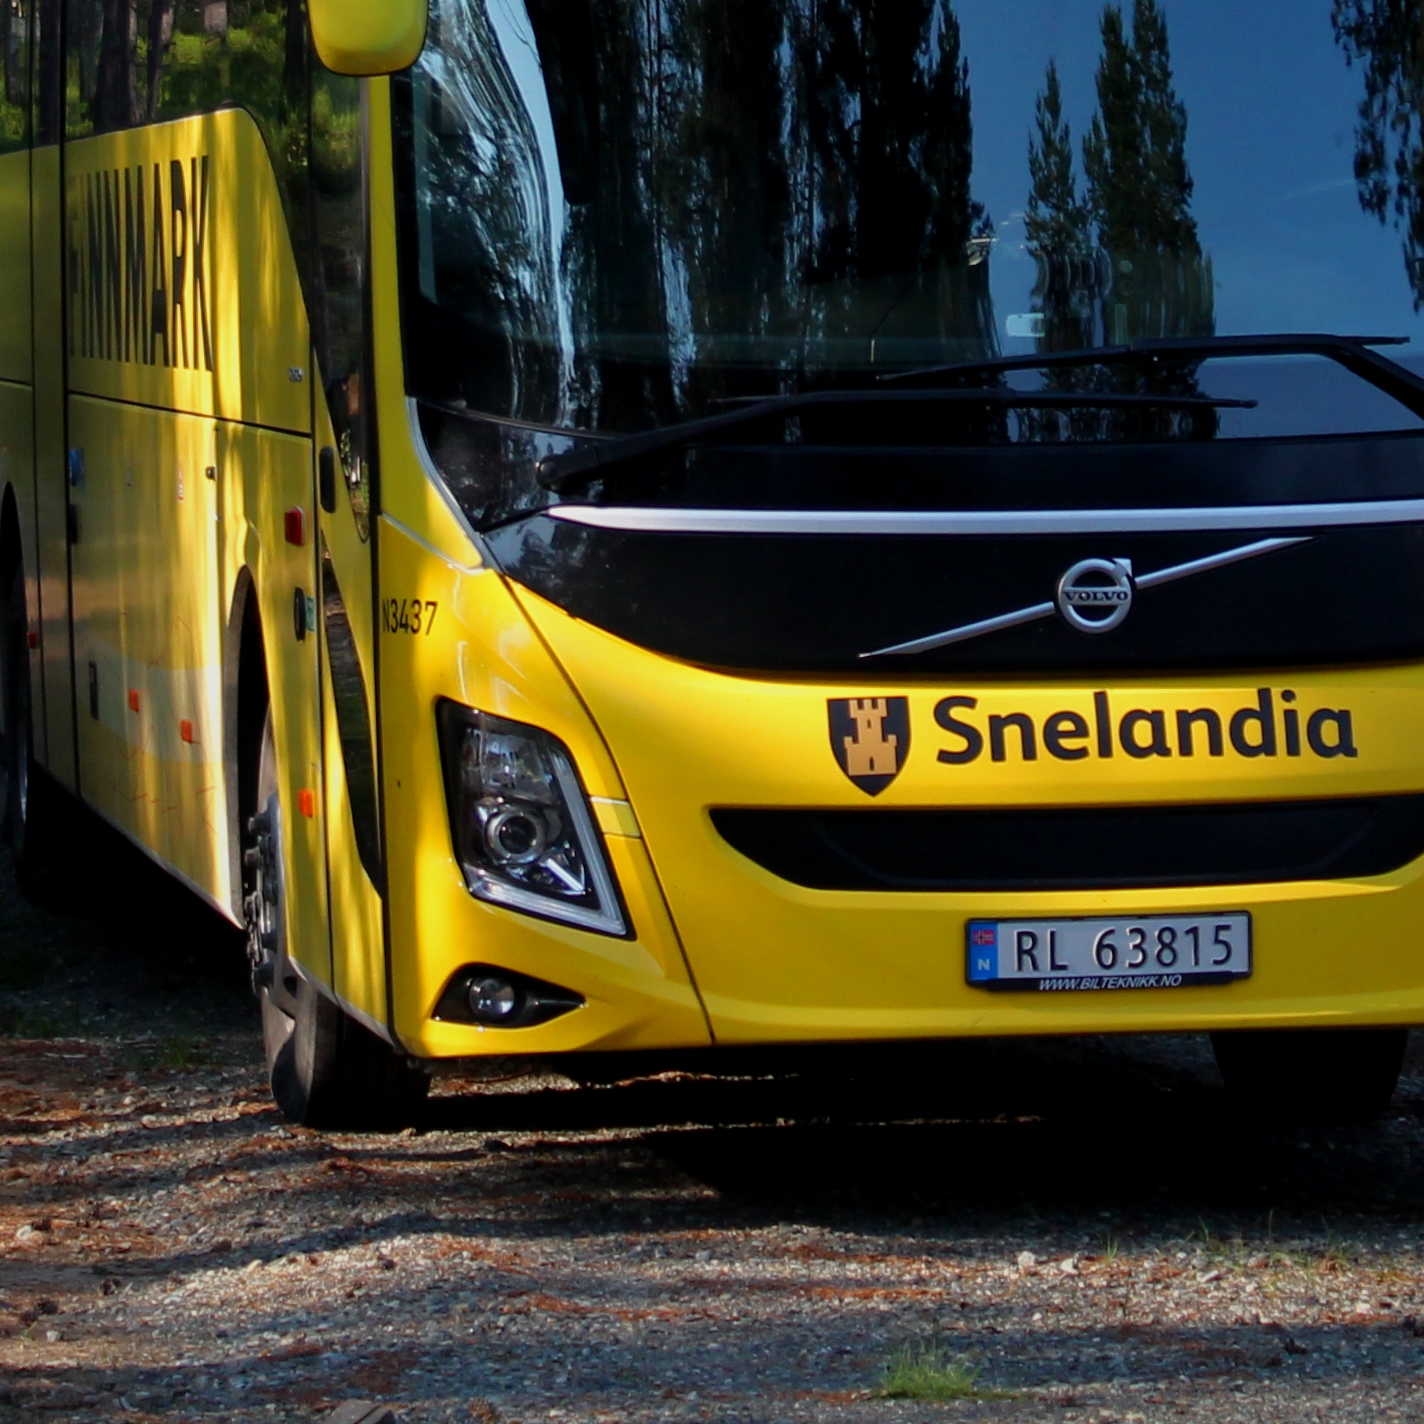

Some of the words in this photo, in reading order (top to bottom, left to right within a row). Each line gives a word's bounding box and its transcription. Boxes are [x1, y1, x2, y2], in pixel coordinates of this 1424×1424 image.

[1063, 590, 1128, 603] VOLVO
[381, 598, 438, 636] N3437
[933, 687, 1358, 764] Snelandia
[1014, 928, 1069, 972] RL
[1093, 924, 1233, 971] 63815
[978, 959, 990, 971] N
[1038, 974, 1183, 991] WWW.BILTEKNIKK.NO
